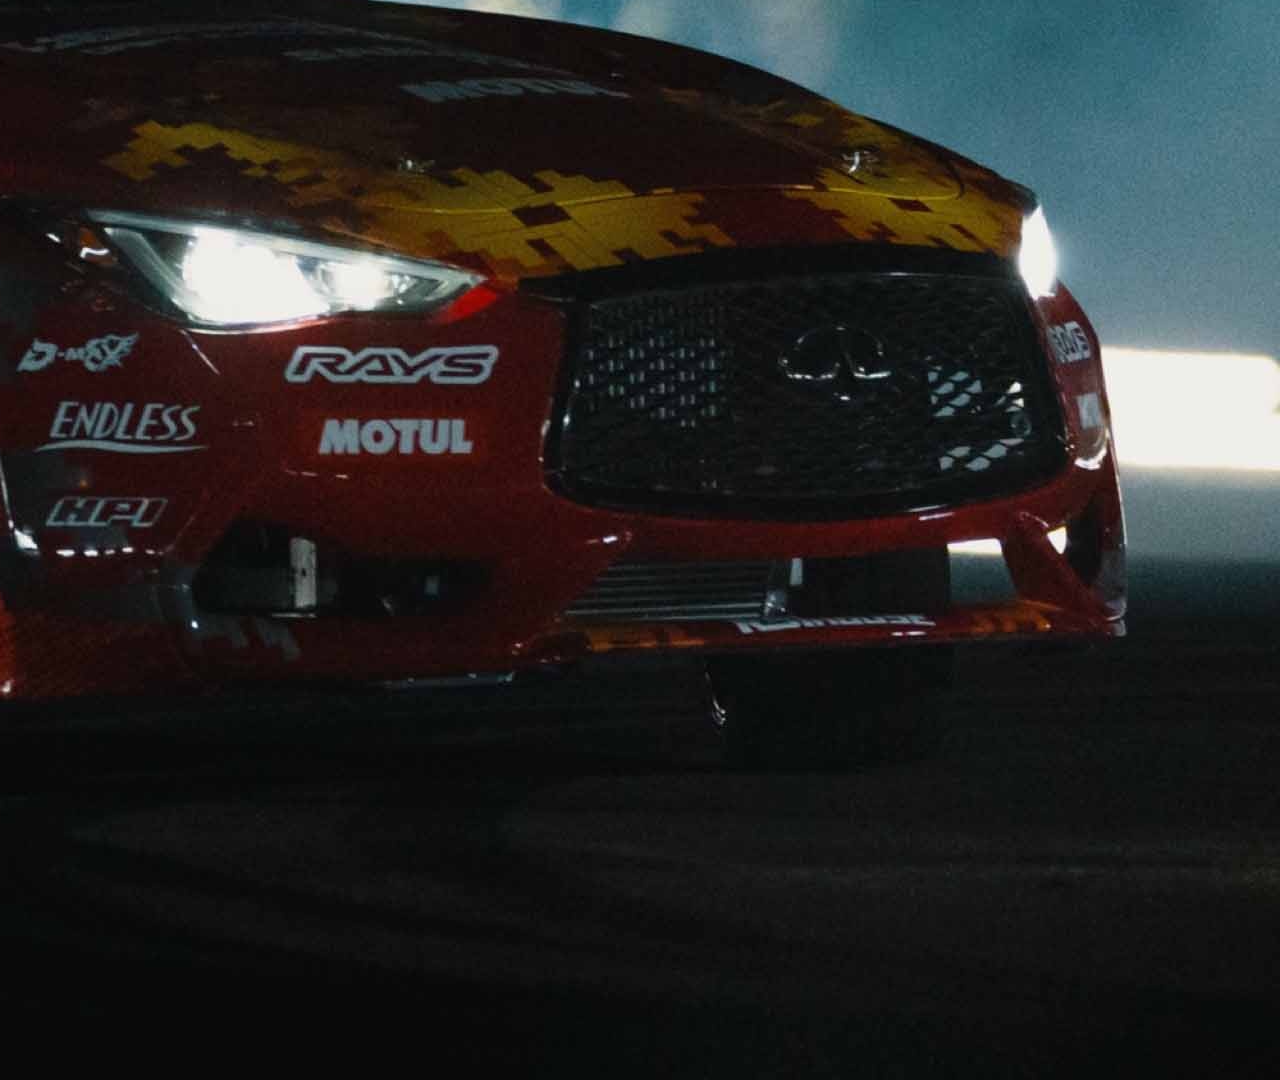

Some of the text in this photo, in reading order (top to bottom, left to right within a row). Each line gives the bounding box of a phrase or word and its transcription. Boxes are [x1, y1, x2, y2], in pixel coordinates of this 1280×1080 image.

[284, 345, 499, 384] RAYS
[49, 401, 201, 441] ENDLESS
[317, 419, 475, 455] MOTUL
